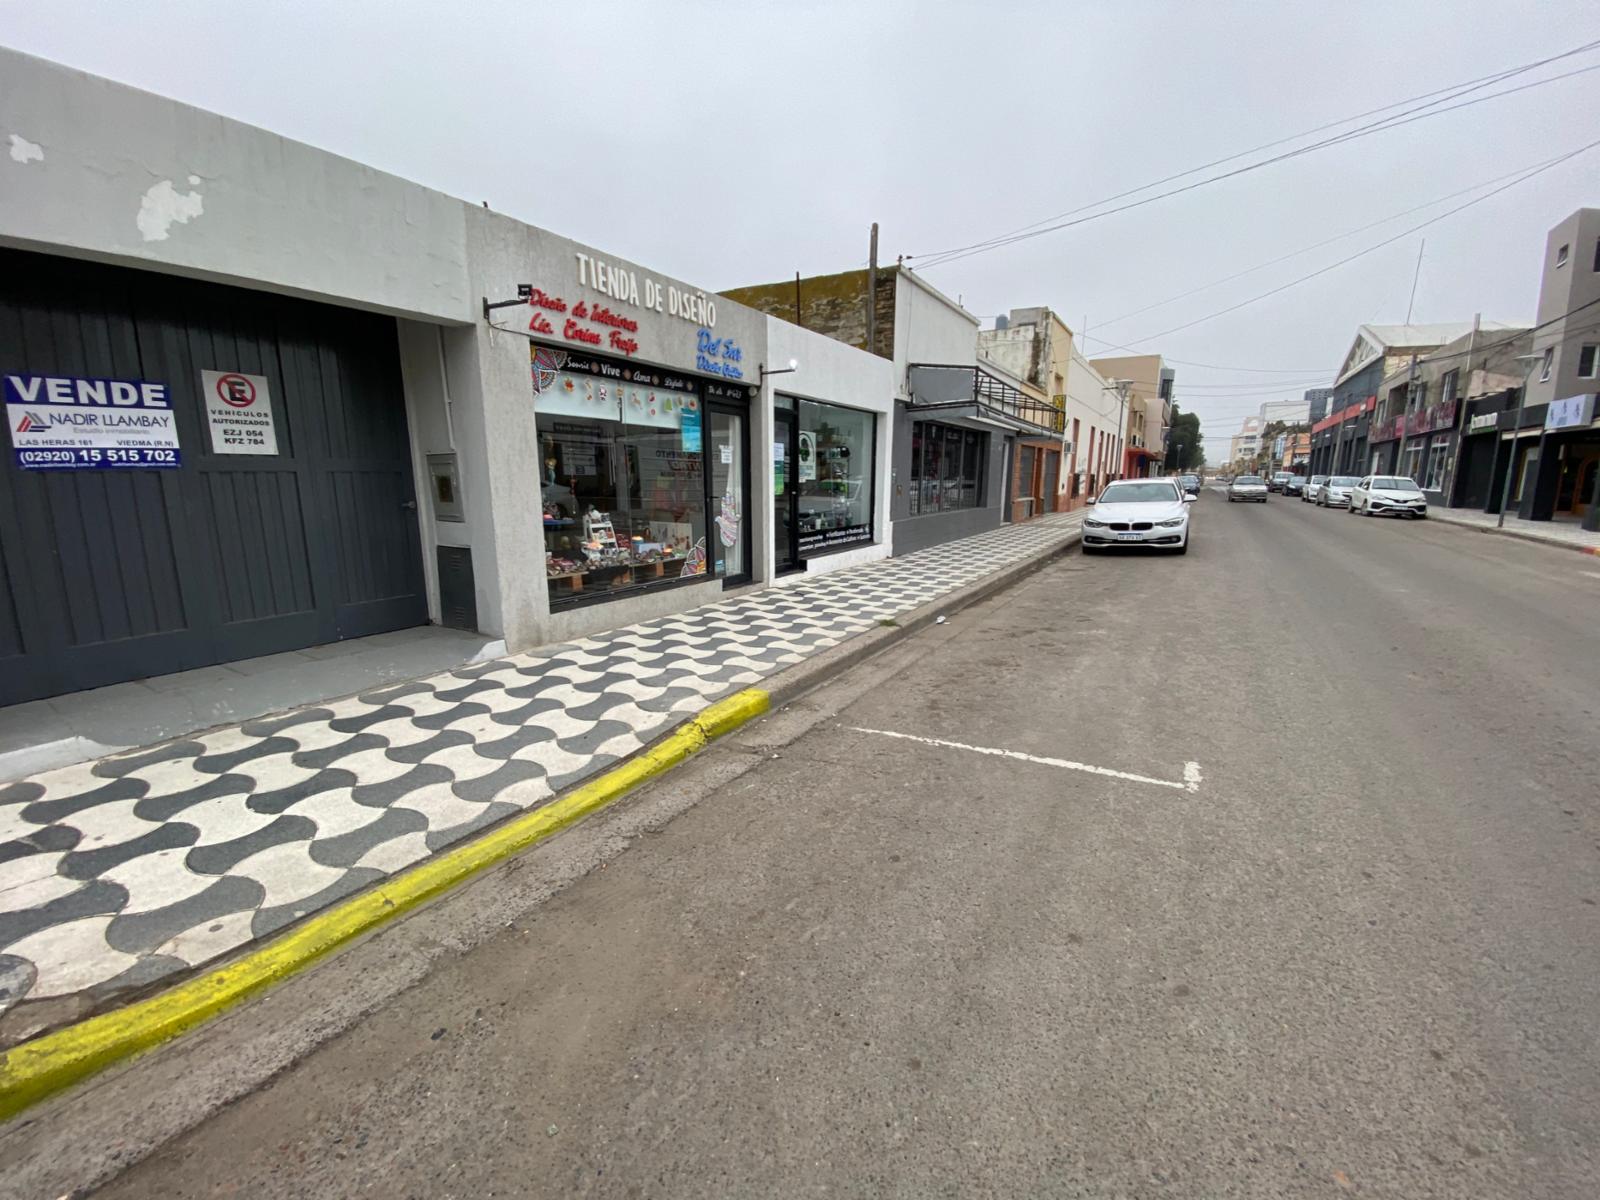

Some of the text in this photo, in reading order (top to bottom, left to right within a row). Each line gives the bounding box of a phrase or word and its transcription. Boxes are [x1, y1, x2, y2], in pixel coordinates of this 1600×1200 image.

[576, 252, 717, 328] TIENDA DE DISEÑO
[601, 364, 621, 376] Vive
[633, 370, 651, 383] Ama
[9, 375, 168, 407] VENDE
[49, 413, 169, 428] NADIR LLAMBAY
[210, 409, 269, 418] VEHICULOS
[212, 418, 270, 426] AUTORIZADOS
[20, 449, 176, 464] (02920) 15 515 702
